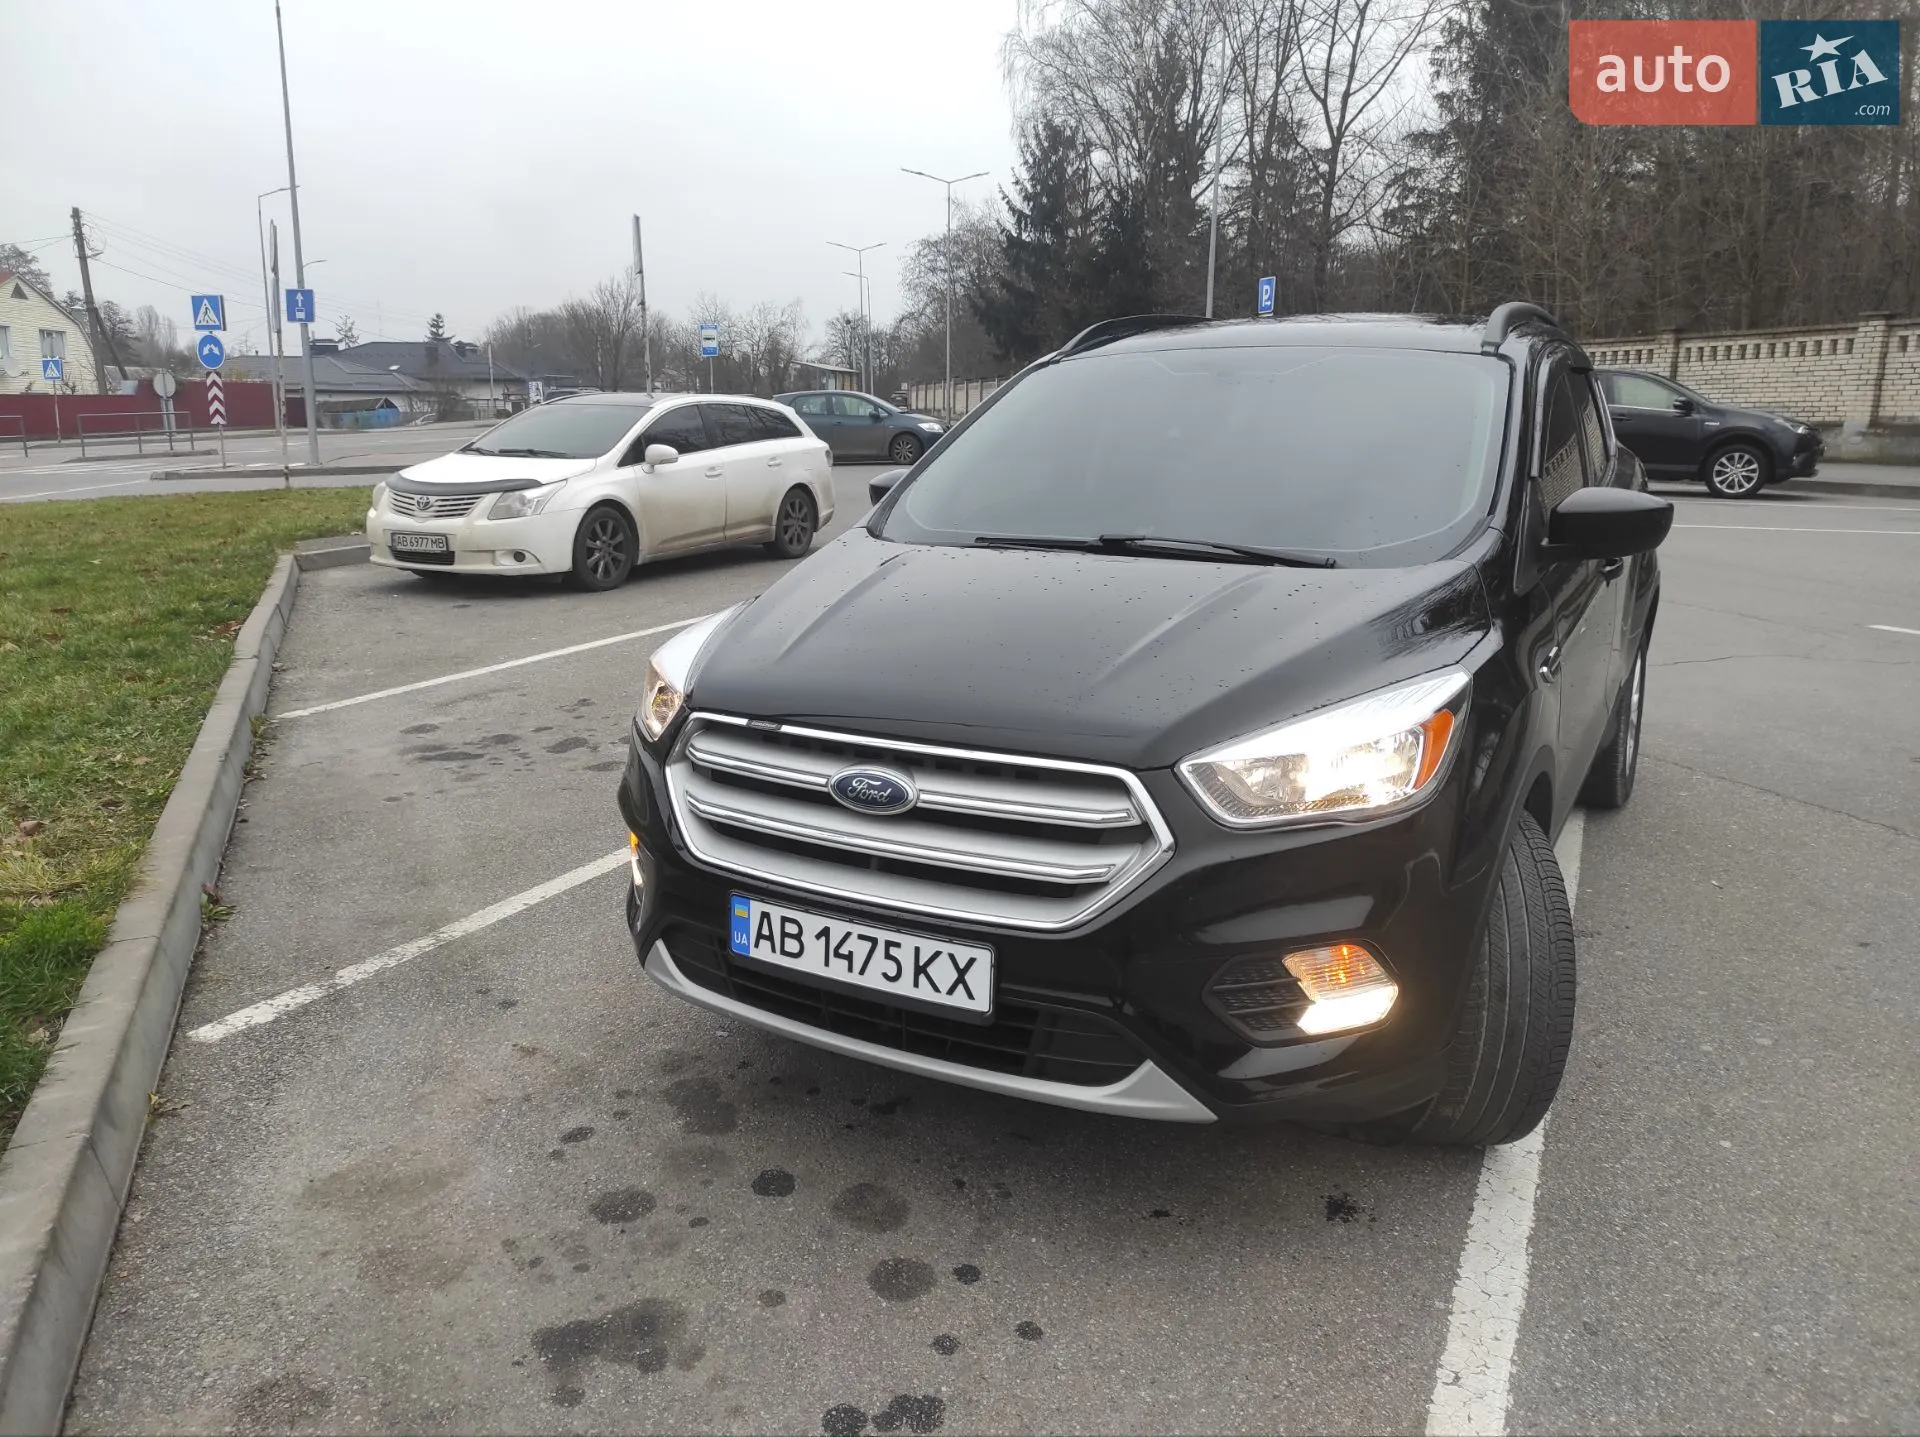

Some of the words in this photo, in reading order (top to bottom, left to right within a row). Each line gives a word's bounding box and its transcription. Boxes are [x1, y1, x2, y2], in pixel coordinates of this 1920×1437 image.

[1262, 284, 1271, 307] P
[847, 777, 892, 802] Ford
[734, 931, 748, 946] UA
